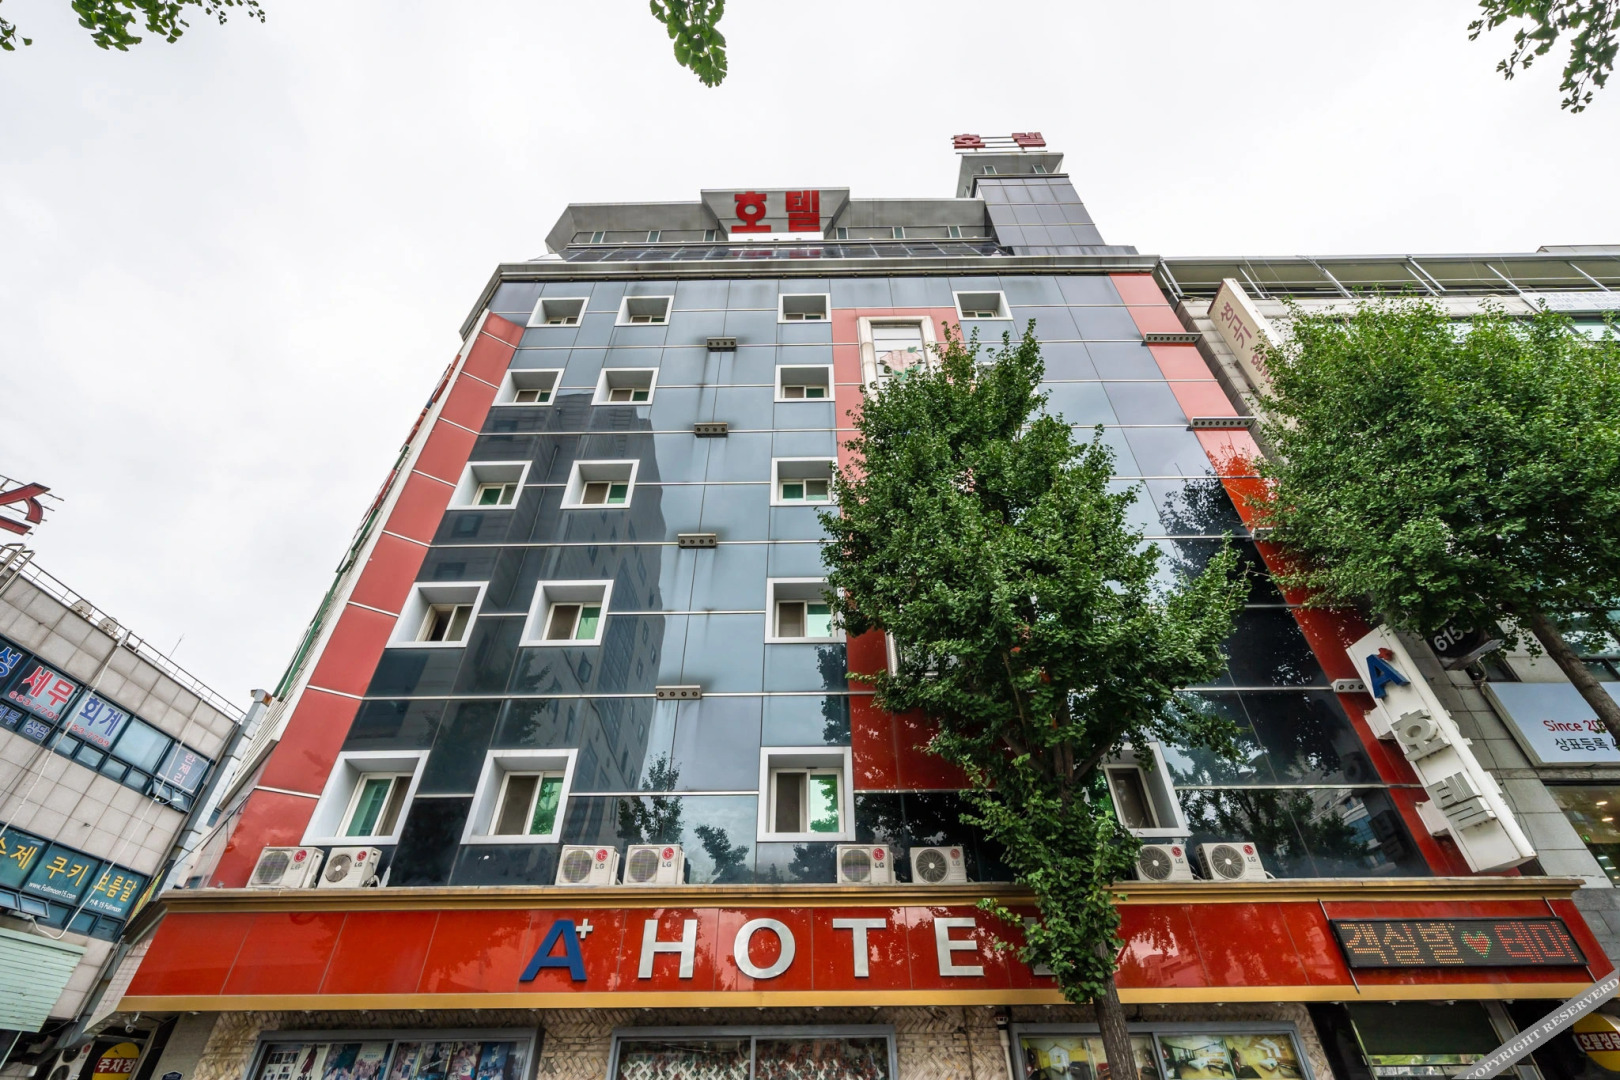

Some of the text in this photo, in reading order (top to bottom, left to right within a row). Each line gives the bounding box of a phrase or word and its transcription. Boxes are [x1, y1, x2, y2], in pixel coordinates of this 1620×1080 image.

[953, 131, 1047, 149] 호텔
[731, 189, 821, 233] 호텔
[22, 666, 76, 707] 세무
[79, 697, 123, 738] 회계
[25, 720, 50, 740] 상담
[1543, 719, 1583, 732] Since
[1555, 737, 1610, 751] 상표등록
[1391, 709, 1498, 831] 호텔
[46, 856, 90, 887] 쿠키
[93, 871, 137, 902] 보름달
[519, 918, 594, 982] A+
[1340, 922, 1579, 965] 객실별 테마
[98, 1058, 135, 1073] 주차장
